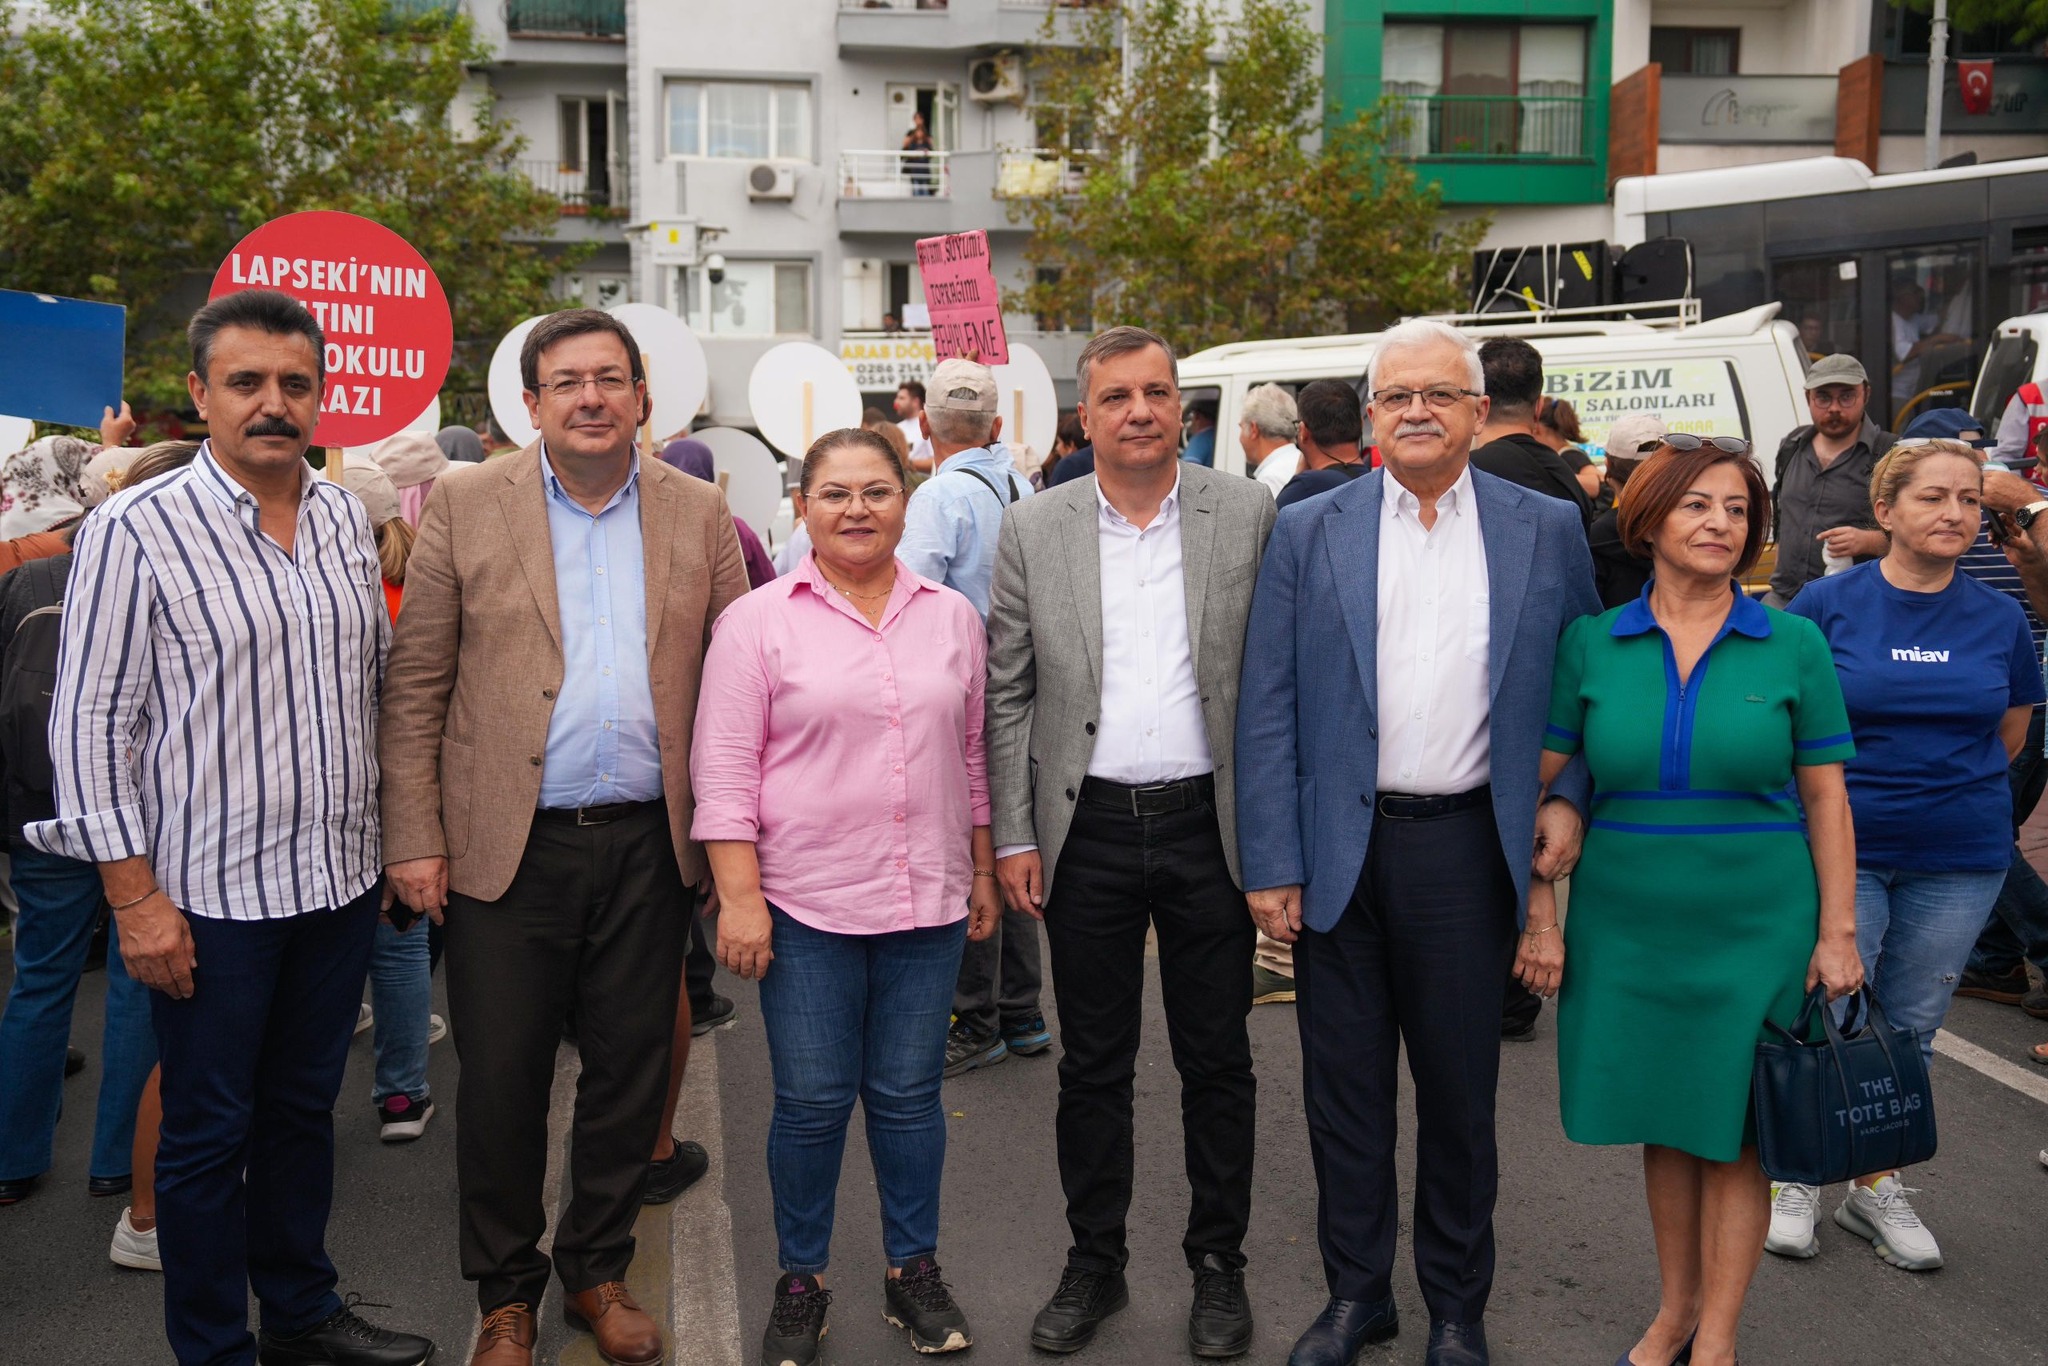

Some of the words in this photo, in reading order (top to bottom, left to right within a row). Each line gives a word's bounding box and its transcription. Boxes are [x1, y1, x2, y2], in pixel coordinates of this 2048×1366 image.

[232, 253, 427, 299] LAPSEKİ'NIN
[929, 274, 981, 306] TOPRAĞIMI
[299, 300, 375, 335] TINI
[842, 344, 890, 359] ARAS
[1586, 393, 1716, 412] SALONLARI
[1891, 646, 1950, 662] miav
[1860, 1076, 1895, 1099] THE
[1835, 1102, 1886, 1127] TOTE
[1889, 1093, 1922, 1116] BAG
